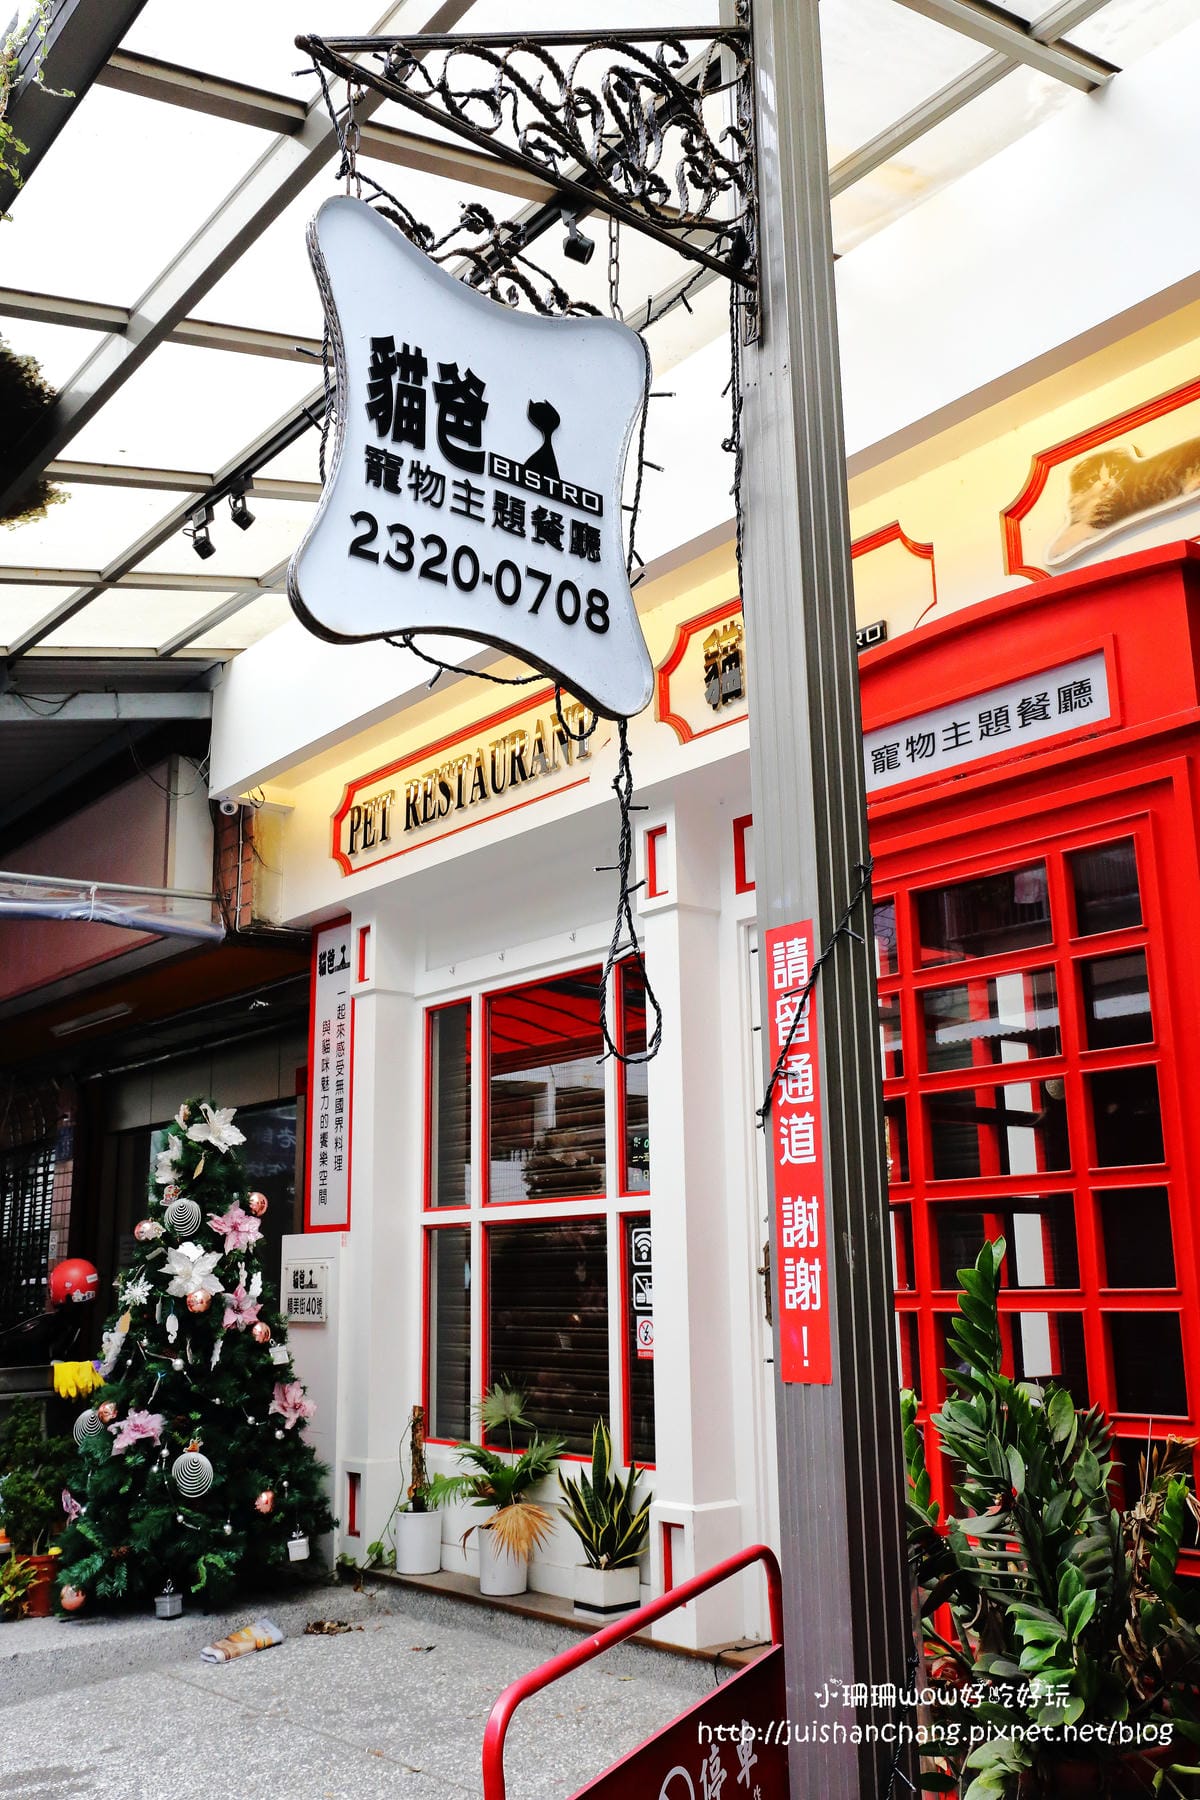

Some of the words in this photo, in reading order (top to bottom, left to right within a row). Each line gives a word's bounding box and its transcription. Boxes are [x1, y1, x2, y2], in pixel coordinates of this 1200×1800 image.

[366, 335, 489, 475] 貓爸
[364, 444, 602, 563] 寵物主題餐廳
[492, 454, 603, 512] BISTRO
[349, 510, 611, 634] 2320-0708
[347, 788, 396, 856] PET
[403, 702, 593, 832] RESTAURANT
[870, 677, 1095, 775] 寵物主題餐廳
[772, 936, 817, 1167] 請留通道
